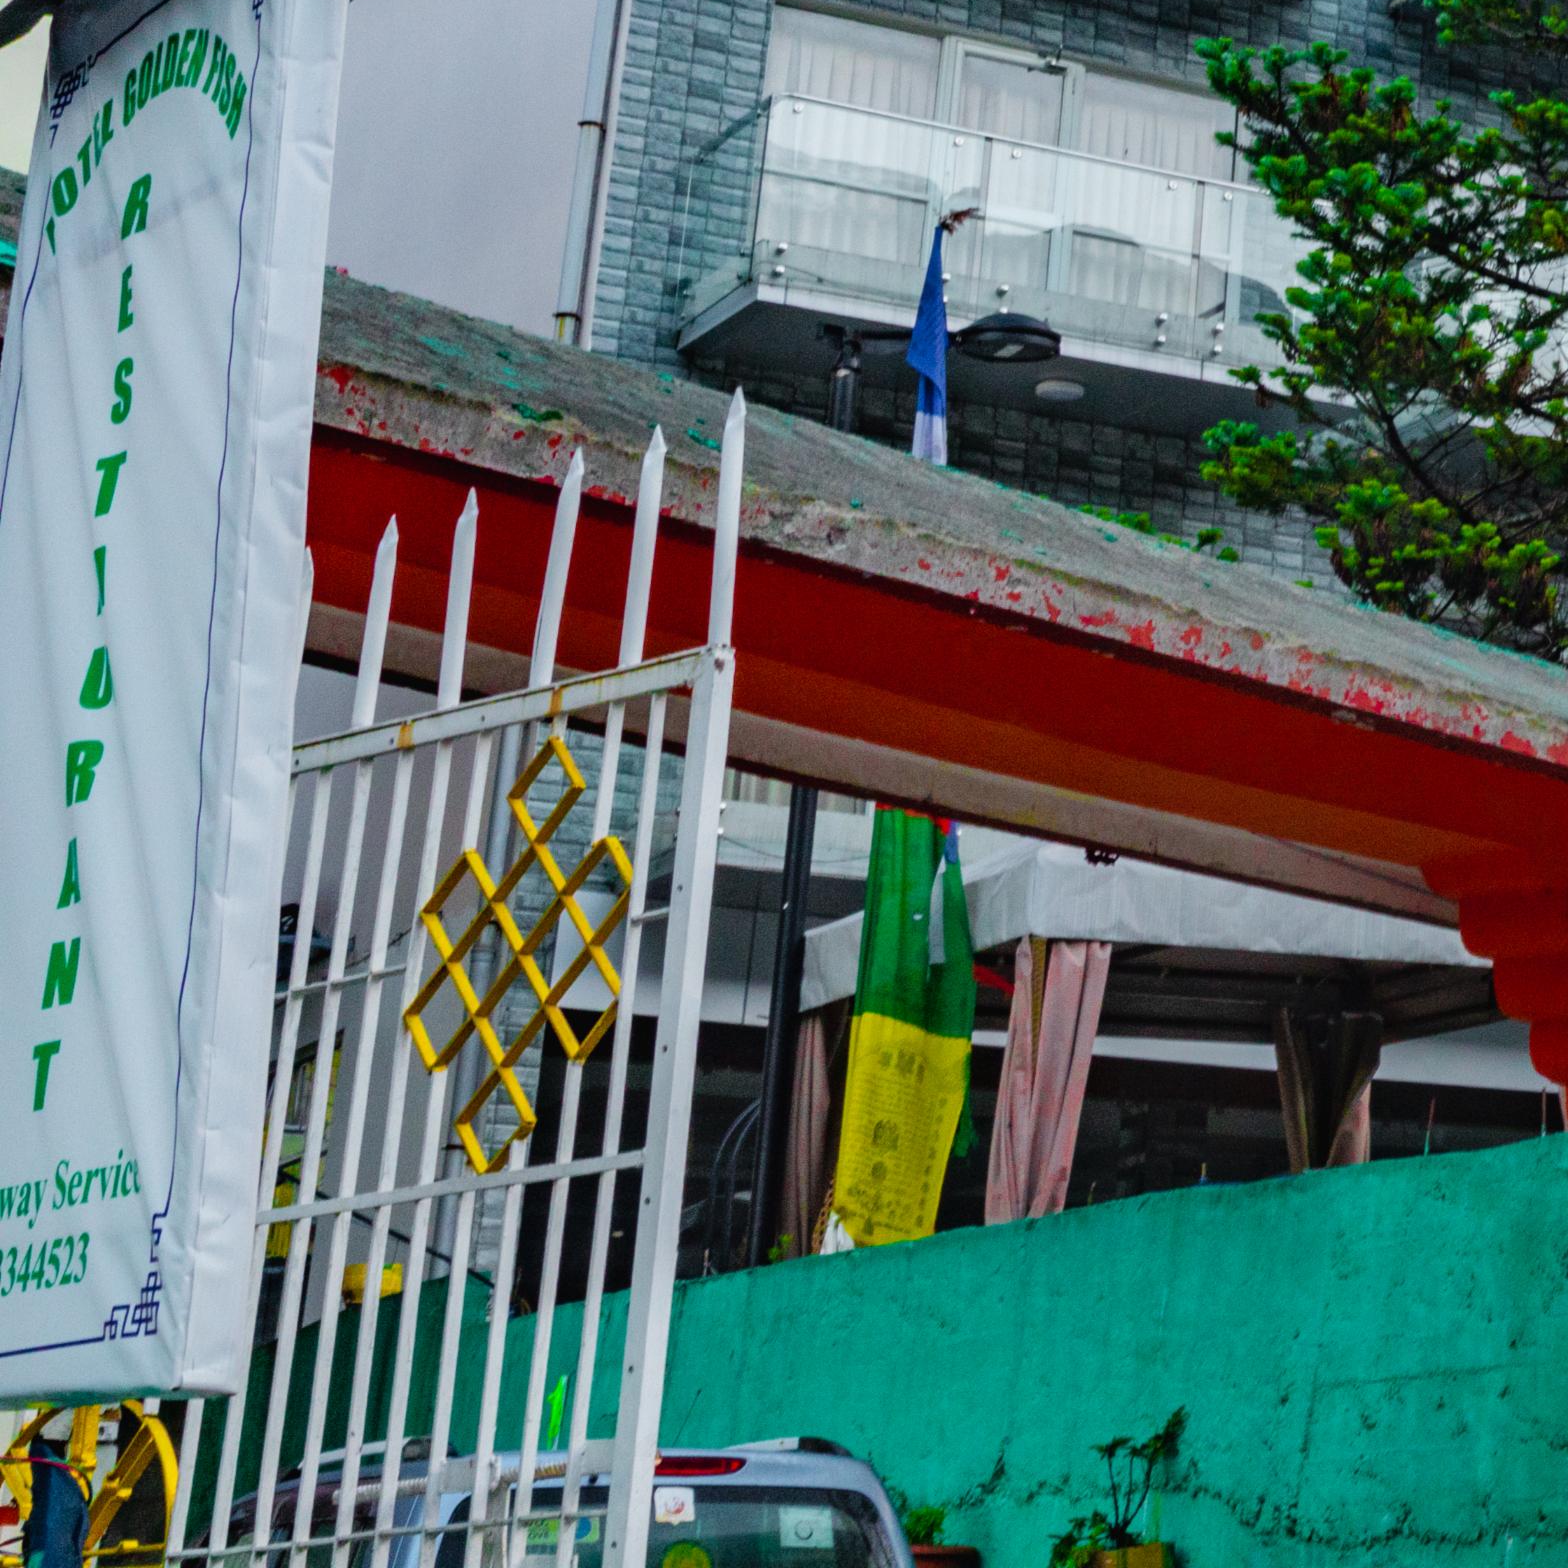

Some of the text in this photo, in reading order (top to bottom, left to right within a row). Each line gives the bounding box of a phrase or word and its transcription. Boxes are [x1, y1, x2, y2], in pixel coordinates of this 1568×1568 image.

[123, 28, 209, 127] GOLDEN
[202, 34, 247, 140] FISH
[0, 1232, 90, 1297] 344523
